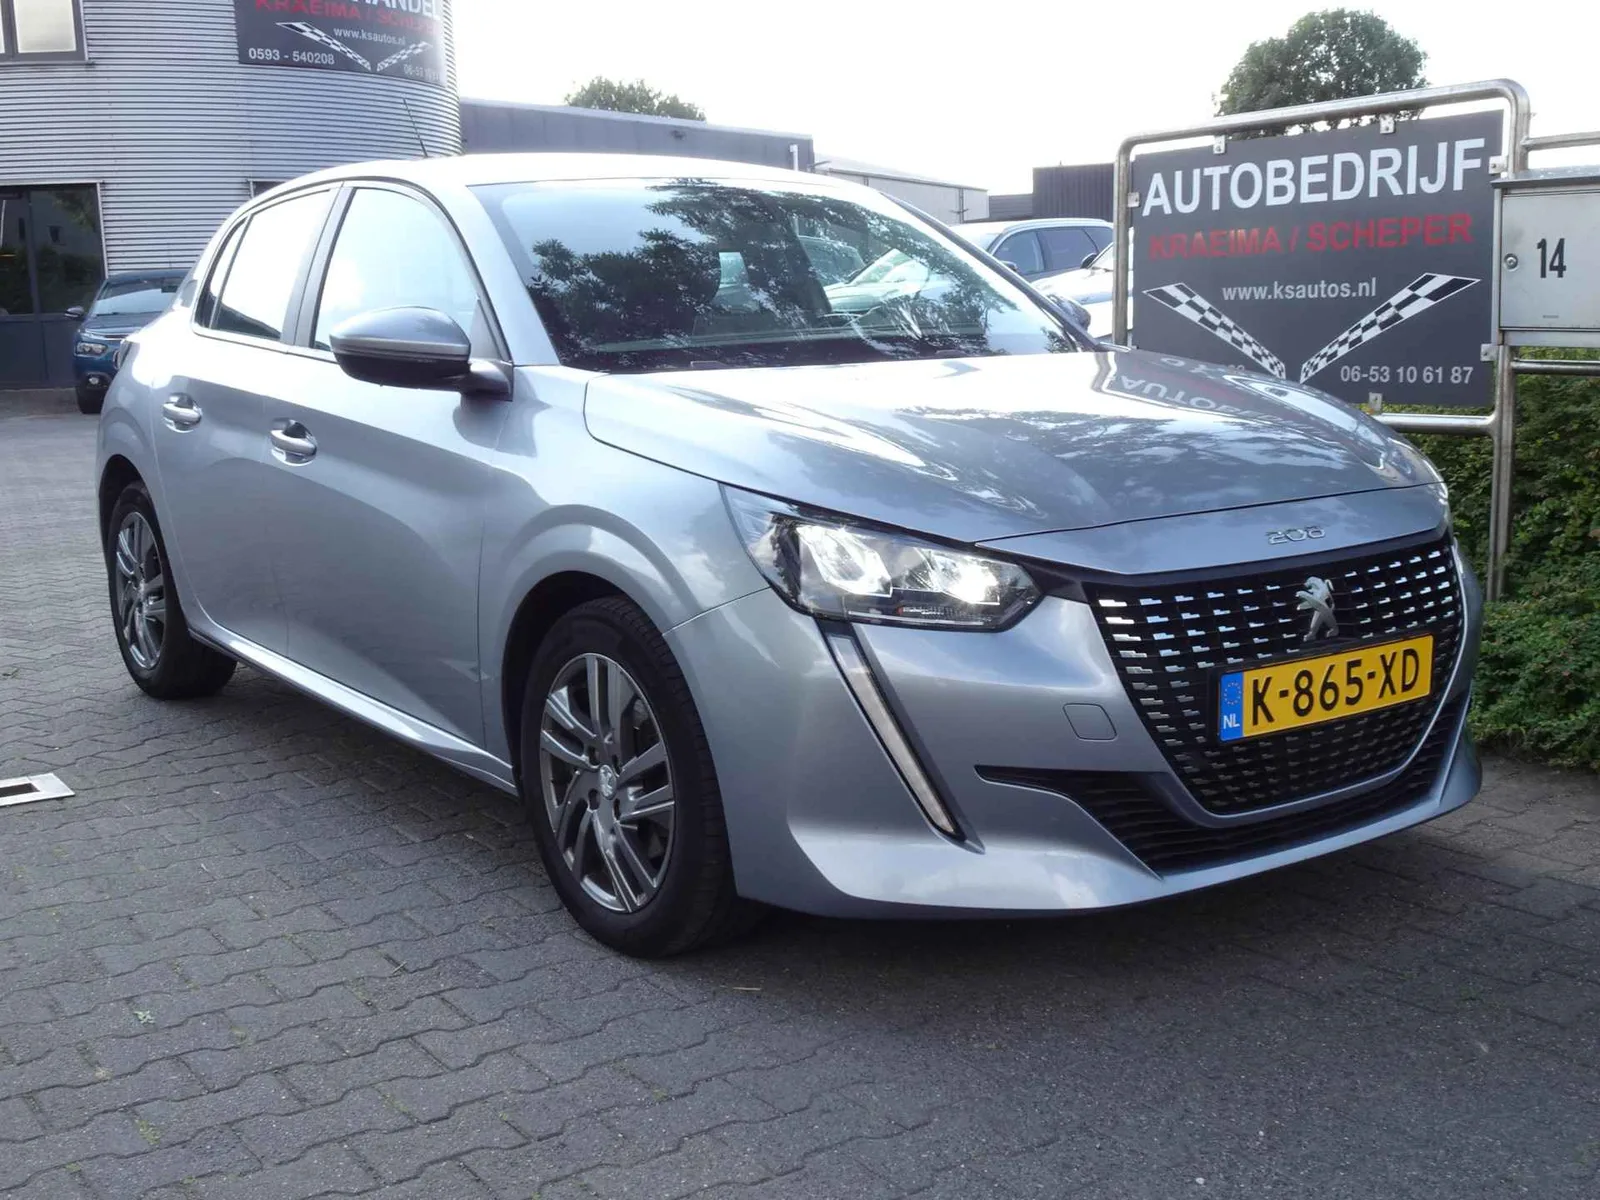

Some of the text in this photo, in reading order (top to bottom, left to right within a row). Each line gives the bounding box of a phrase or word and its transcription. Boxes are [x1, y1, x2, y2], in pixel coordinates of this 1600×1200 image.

[333, 27, 406, 44] www.ksautos.nl
[248, 47, 280, 61] 0593
[292, 50, 335, 65] 540208
[1142, 138, 1485, 217] AUTOBEDRIJF
[1149, 213, 1475, 260] KRAEIMA / SCHEPER
[1537, 237, 1567, 278] 14
[1222, 277, 1377, 301] www.ksautos.nl
[1340, 365, 1474, 384] 06-53 10 61 87
[1267, 526, 1326, 545] 208
[1252, 648, 1419, 726] K-865-XD
[1223, 714, 1240, 729] NL
